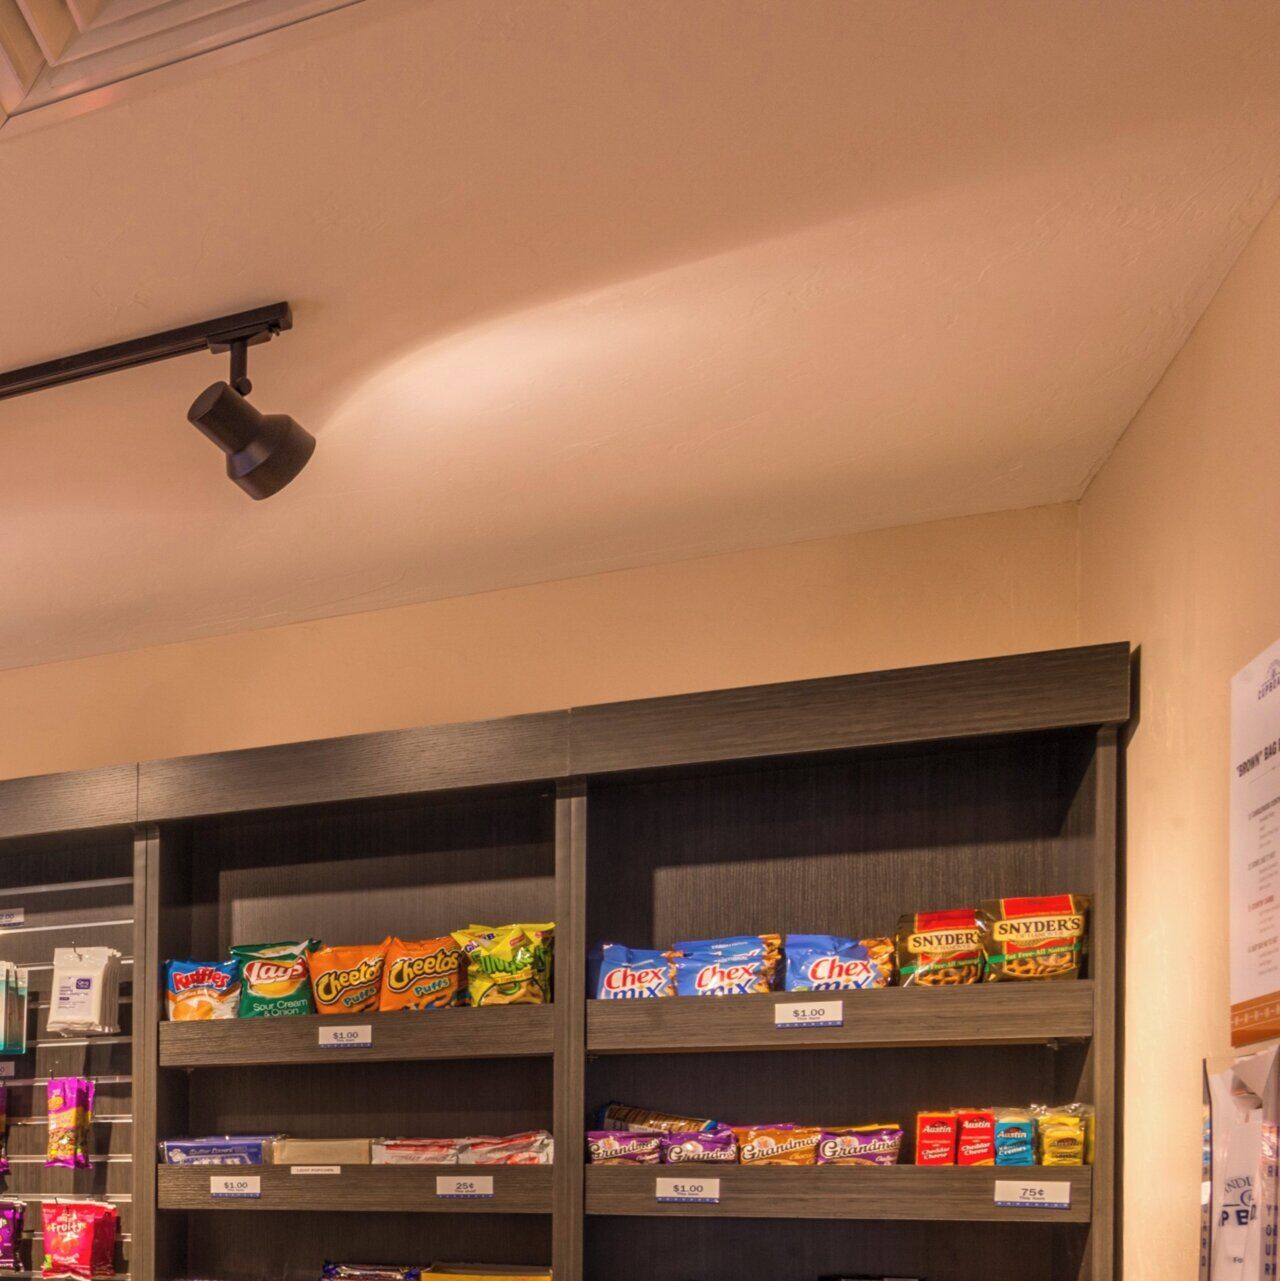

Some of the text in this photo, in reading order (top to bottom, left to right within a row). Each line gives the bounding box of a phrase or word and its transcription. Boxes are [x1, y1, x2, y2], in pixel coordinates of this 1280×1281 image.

[998, 917, 1081, 935] SNYDER'S
[389, 948, 461, 990] Cheetos
[696, 963, 755, 990] Chex
[811, 957, 873, 983] Chex
[173, 967, 230, 992] Ruffles
[605, 967, 665, 990] Chex
[413, 978, 450, 997] Puffs
[253, 998, 308, 1012] Sour Cream
[793, 1008, 825, 1018] $1.00
[332, 1031, 359, 1039] $1.00
[922, 1125, 952, 1134] Austin
[963, 1120, 991, 1129] Austin
[455, 1182, 474, 1191] 25¢
[1020, 1188, 1044, 1197] 75¢
